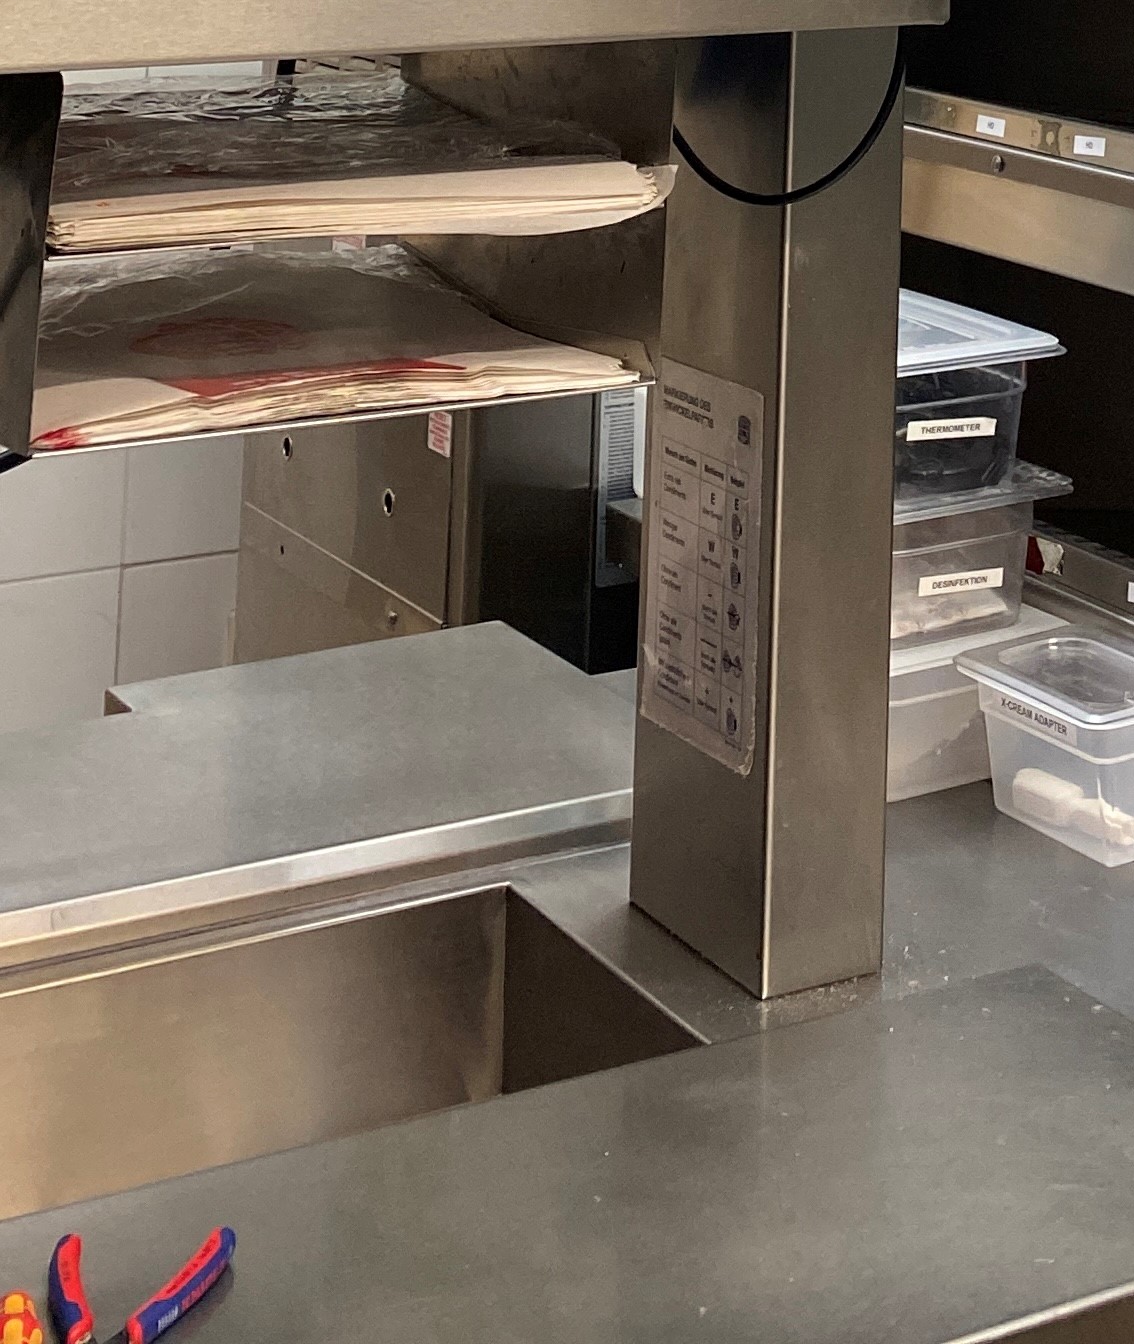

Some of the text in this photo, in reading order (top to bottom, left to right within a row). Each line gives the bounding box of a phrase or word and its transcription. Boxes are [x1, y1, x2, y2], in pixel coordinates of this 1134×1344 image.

[921, 423, 981, 435] THERMOMETER
[931, 575, 988, 590] DESINFEKTION
[1001, 697, 1068, 736] X-CREAM ADAPTER
